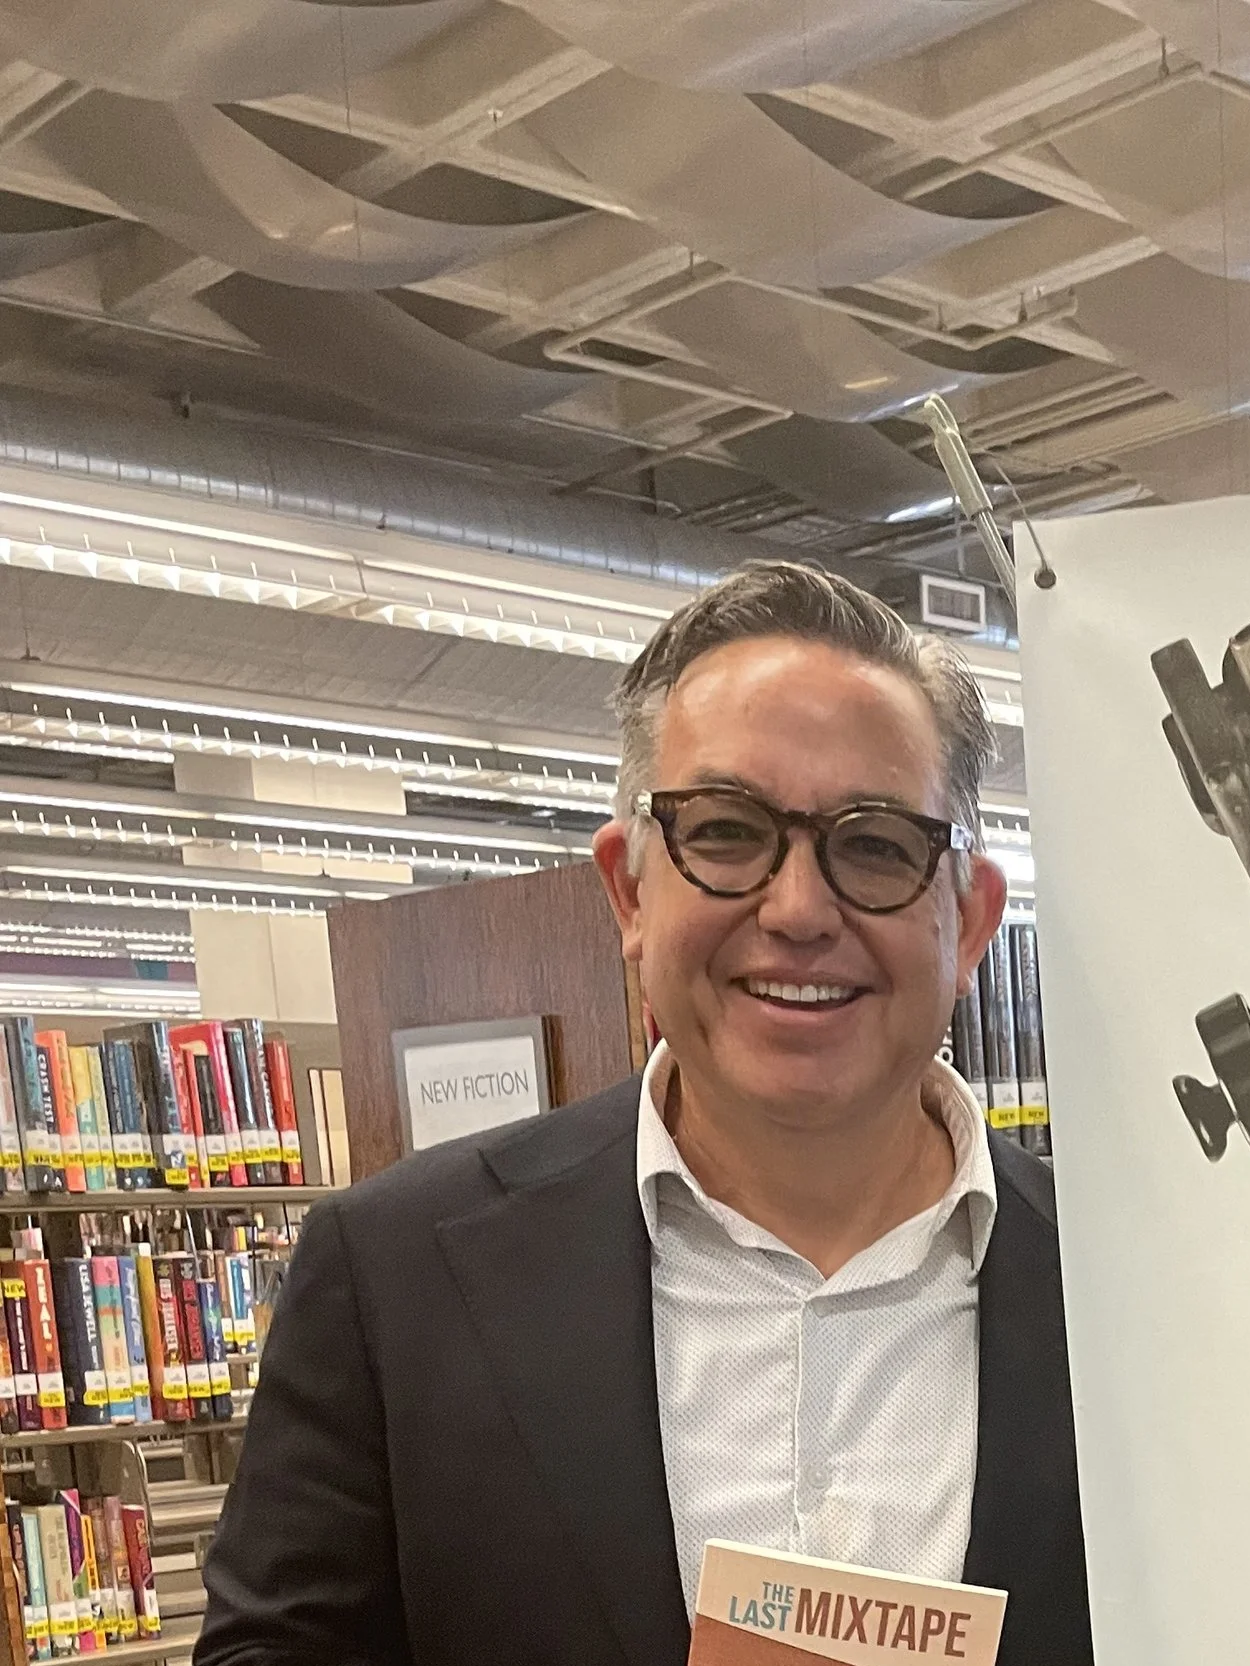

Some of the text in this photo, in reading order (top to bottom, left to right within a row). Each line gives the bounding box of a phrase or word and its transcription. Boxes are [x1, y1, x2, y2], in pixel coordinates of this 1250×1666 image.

[420, 1069, 529, 1106] NEW FICTION
[762, 1581, 795, 1605] THE
[729, 1587, 972, 1658] LAST MIXTAPE
